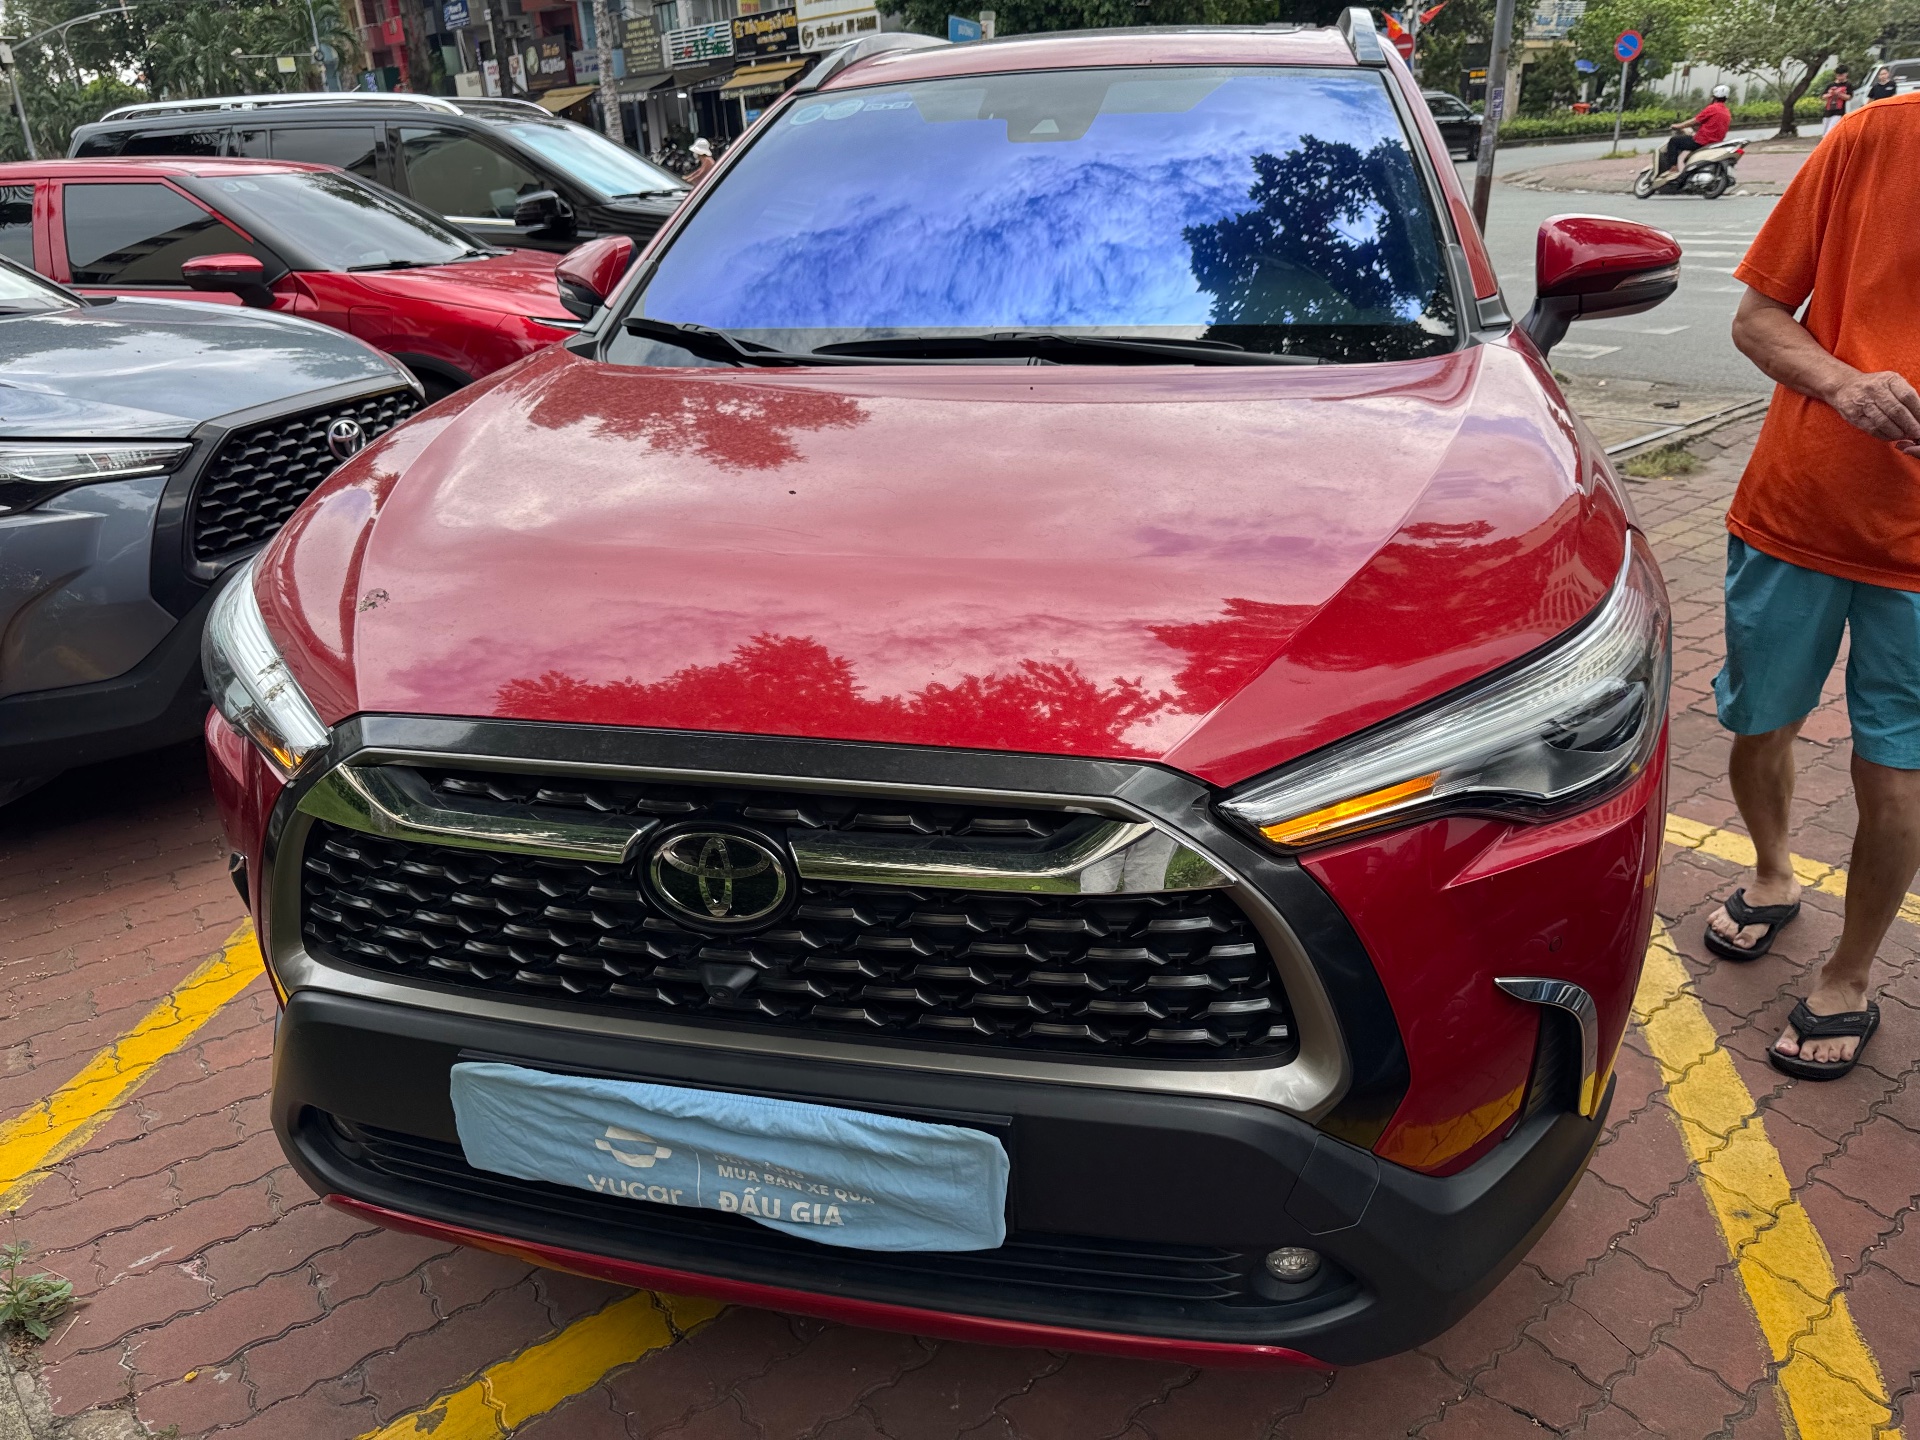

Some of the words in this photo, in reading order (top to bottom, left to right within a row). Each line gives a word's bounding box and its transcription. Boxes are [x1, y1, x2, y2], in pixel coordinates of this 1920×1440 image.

[587, 1173, 683, 1205] vucar
[718, 1165, 760, 1183] MUA
[806, 1182, 829, 1196] XE
[718, 1187, 781, 1219] ĐẤU
[790, 1201, 845, 1226] GIÁ
